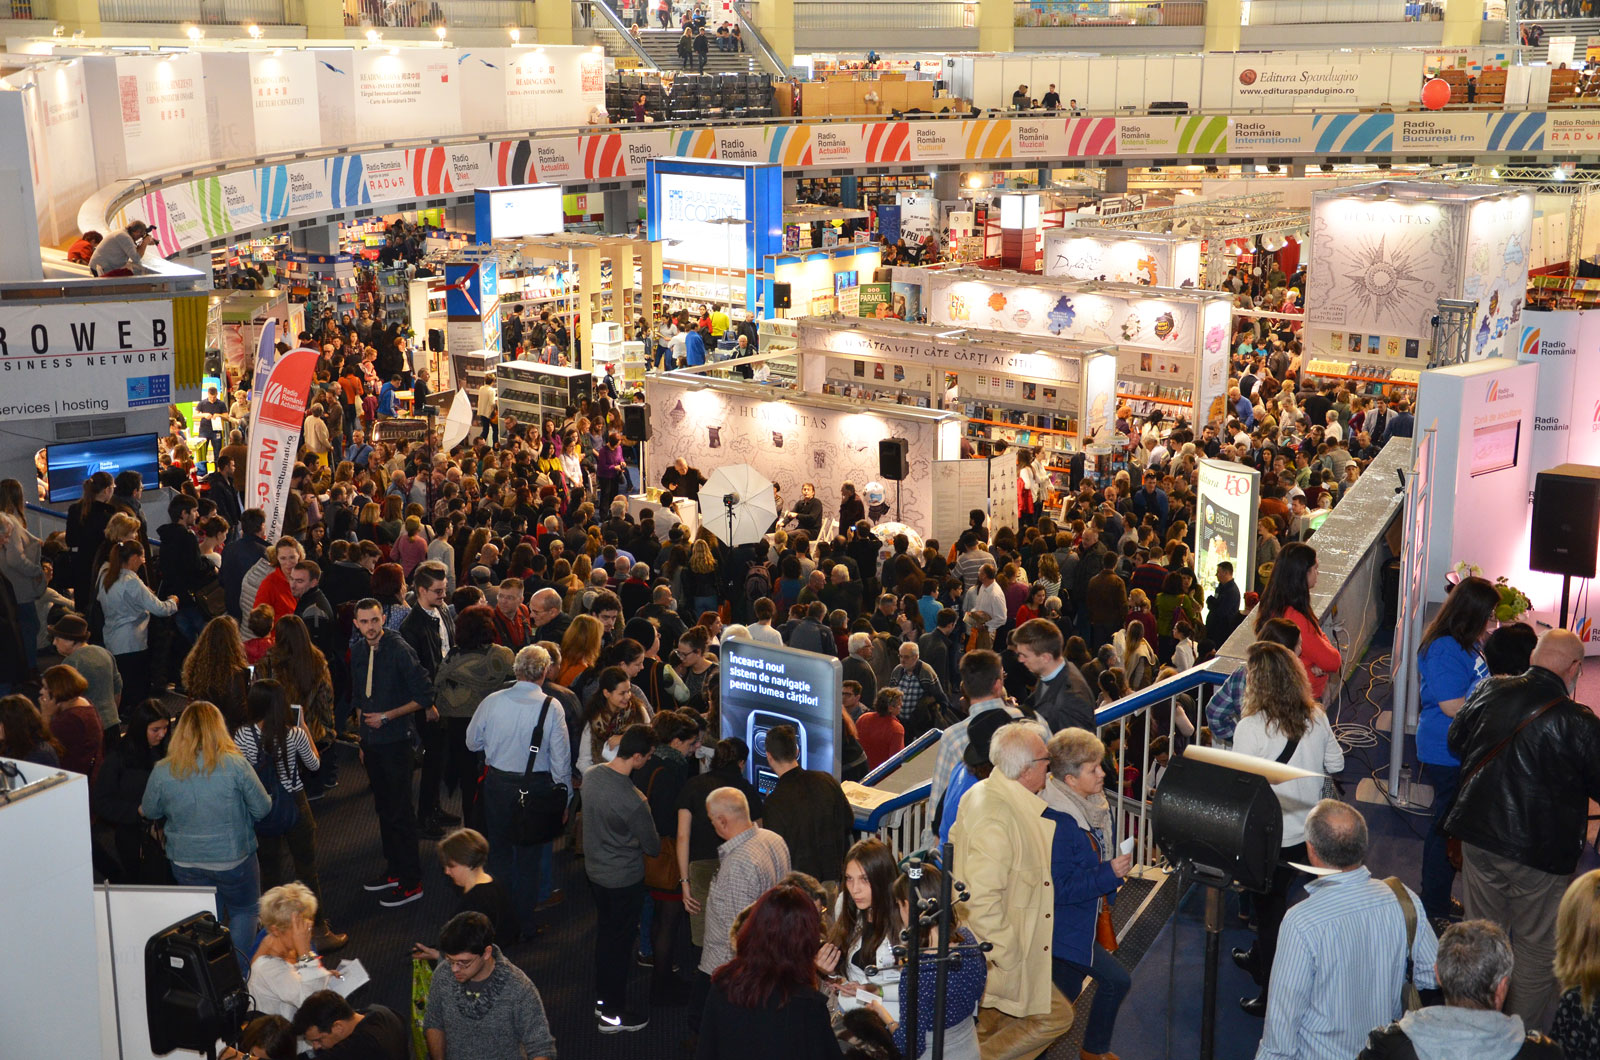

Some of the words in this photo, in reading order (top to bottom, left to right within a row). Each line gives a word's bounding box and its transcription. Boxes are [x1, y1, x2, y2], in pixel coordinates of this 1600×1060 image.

[1260, 72, 1297, 83] Editura
[1300, 66, 1358, 85] Spandugino
[1240, 87, 1355, 96] www.edituraspandugino.ro
[818, 132, 837, 140] Radio
[1019, 133, 1049, 141] România
[1235, 129, 1281, 137] România
[818, 139, 846, 147] România
[917, 136, 946, 144] România
[1403, 135, 1457, 143] București
[629, 144, 652, 154] Radio
[721, 140, 744, 149] Radio
[538, 147, 555, 155] Radio
[722, 149, 758, 159] România
[452, 154, 469, 162] Radio
[539, 155, 564, 164] România
[366, 162, 380, 171] Radio
[380, 161, 401, 170] România
[454, 162, 479, 172] România
[290, 173, 305, 182] Radio
[291, 181, 312, 193] România
[1541, 341, 1566, 349] Radio
[1541, 347, 1576, 356] România
[87, 351, 168, 366] NETWORK
[992, 356, 1004, 366] AI
[283, 387, 298, 398] Radio
[62, 398, 109, 411] hosting
[1534, 423, 1569, 431] România
[258, 437, 279, 477] FM
[1215, 512, 1233, 530] BIBLIA
[729, 651, 764, 669] Încearcă
[765, 663, 785, 674] noul
[729, 667, 758, 681] sistem
[758, 672, 770, 683] de
[771, 676, 811, 692] navigație
[729, 679, 758, 693] pentru
[758, 684, 785, 699] lumea
[786, 691, 819, 706] cărților!
